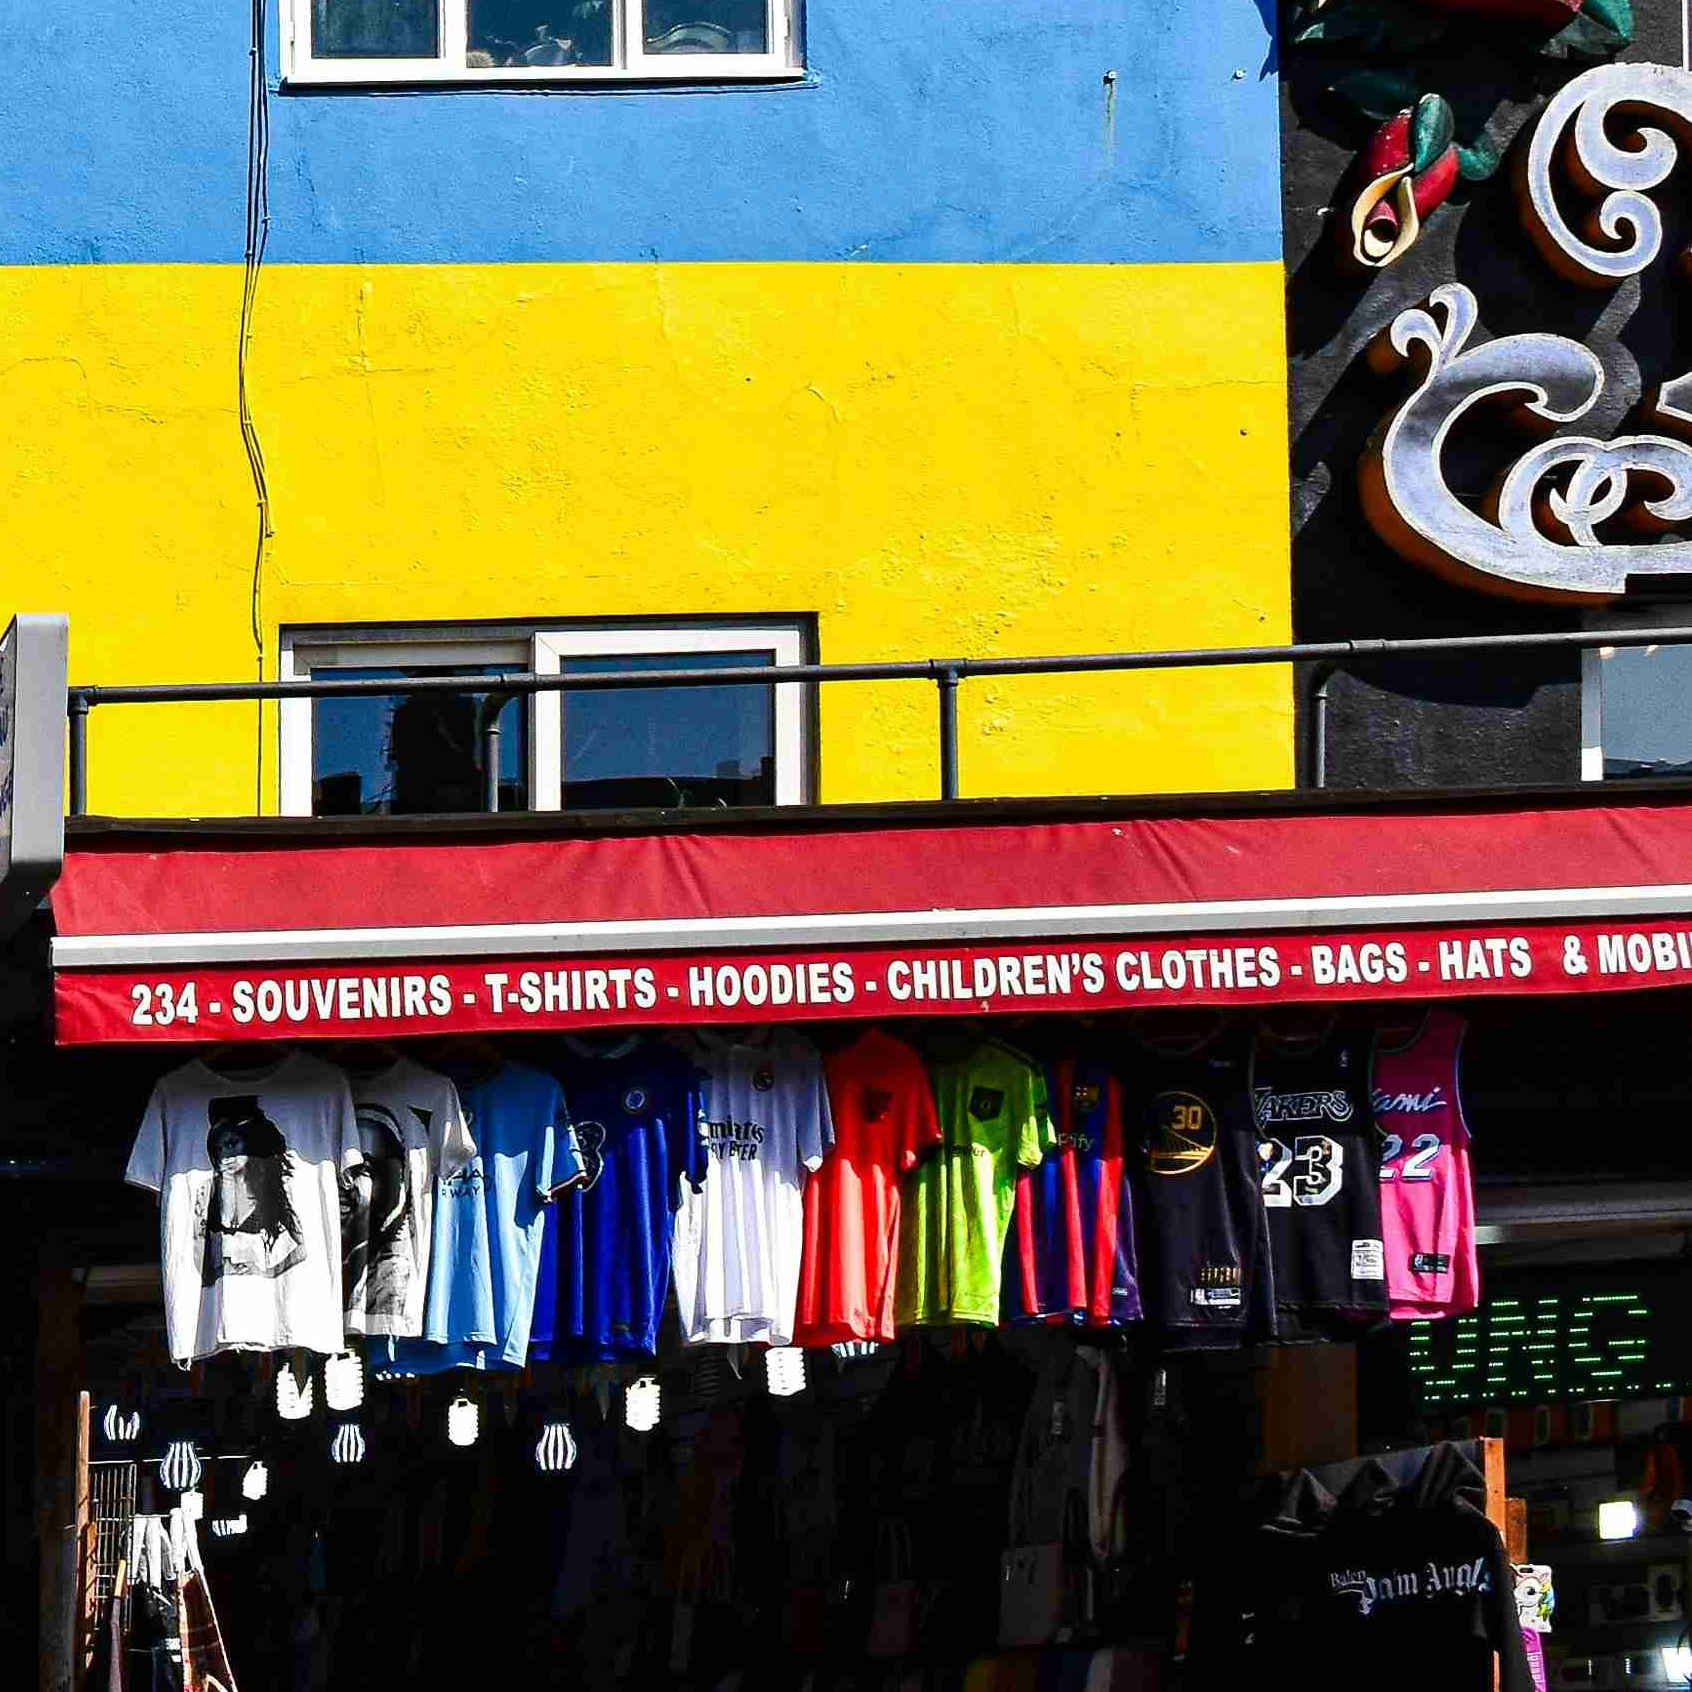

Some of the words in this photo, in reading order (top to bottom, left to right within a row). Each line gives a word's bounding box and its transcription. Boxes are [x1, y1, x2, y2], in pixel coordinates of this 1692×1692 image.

[131, 982, 200, 1026] 234
[231, 973, 453, 1024] SOUVENIRS
[483, 967, 658, 1016] T-SHIRTS
[688, 961, 856, 1007] HOODIES
[886, 952, 1106, 1001] CHILDREN'S
[1114, 945, 1282, 993] CLOTHES
[1310, 941, 1409, 986] BAGS
[1438, 937, 1533, 982] HATS
[1562, 934, 1590, 976] &
[1596, 930, 1692, 975] MOBI
[1171, 1105, 1202, 1131] 30
[1256, 1135, 1344, 1209] 23
[1378, 1134, 1442, 1182] 22
